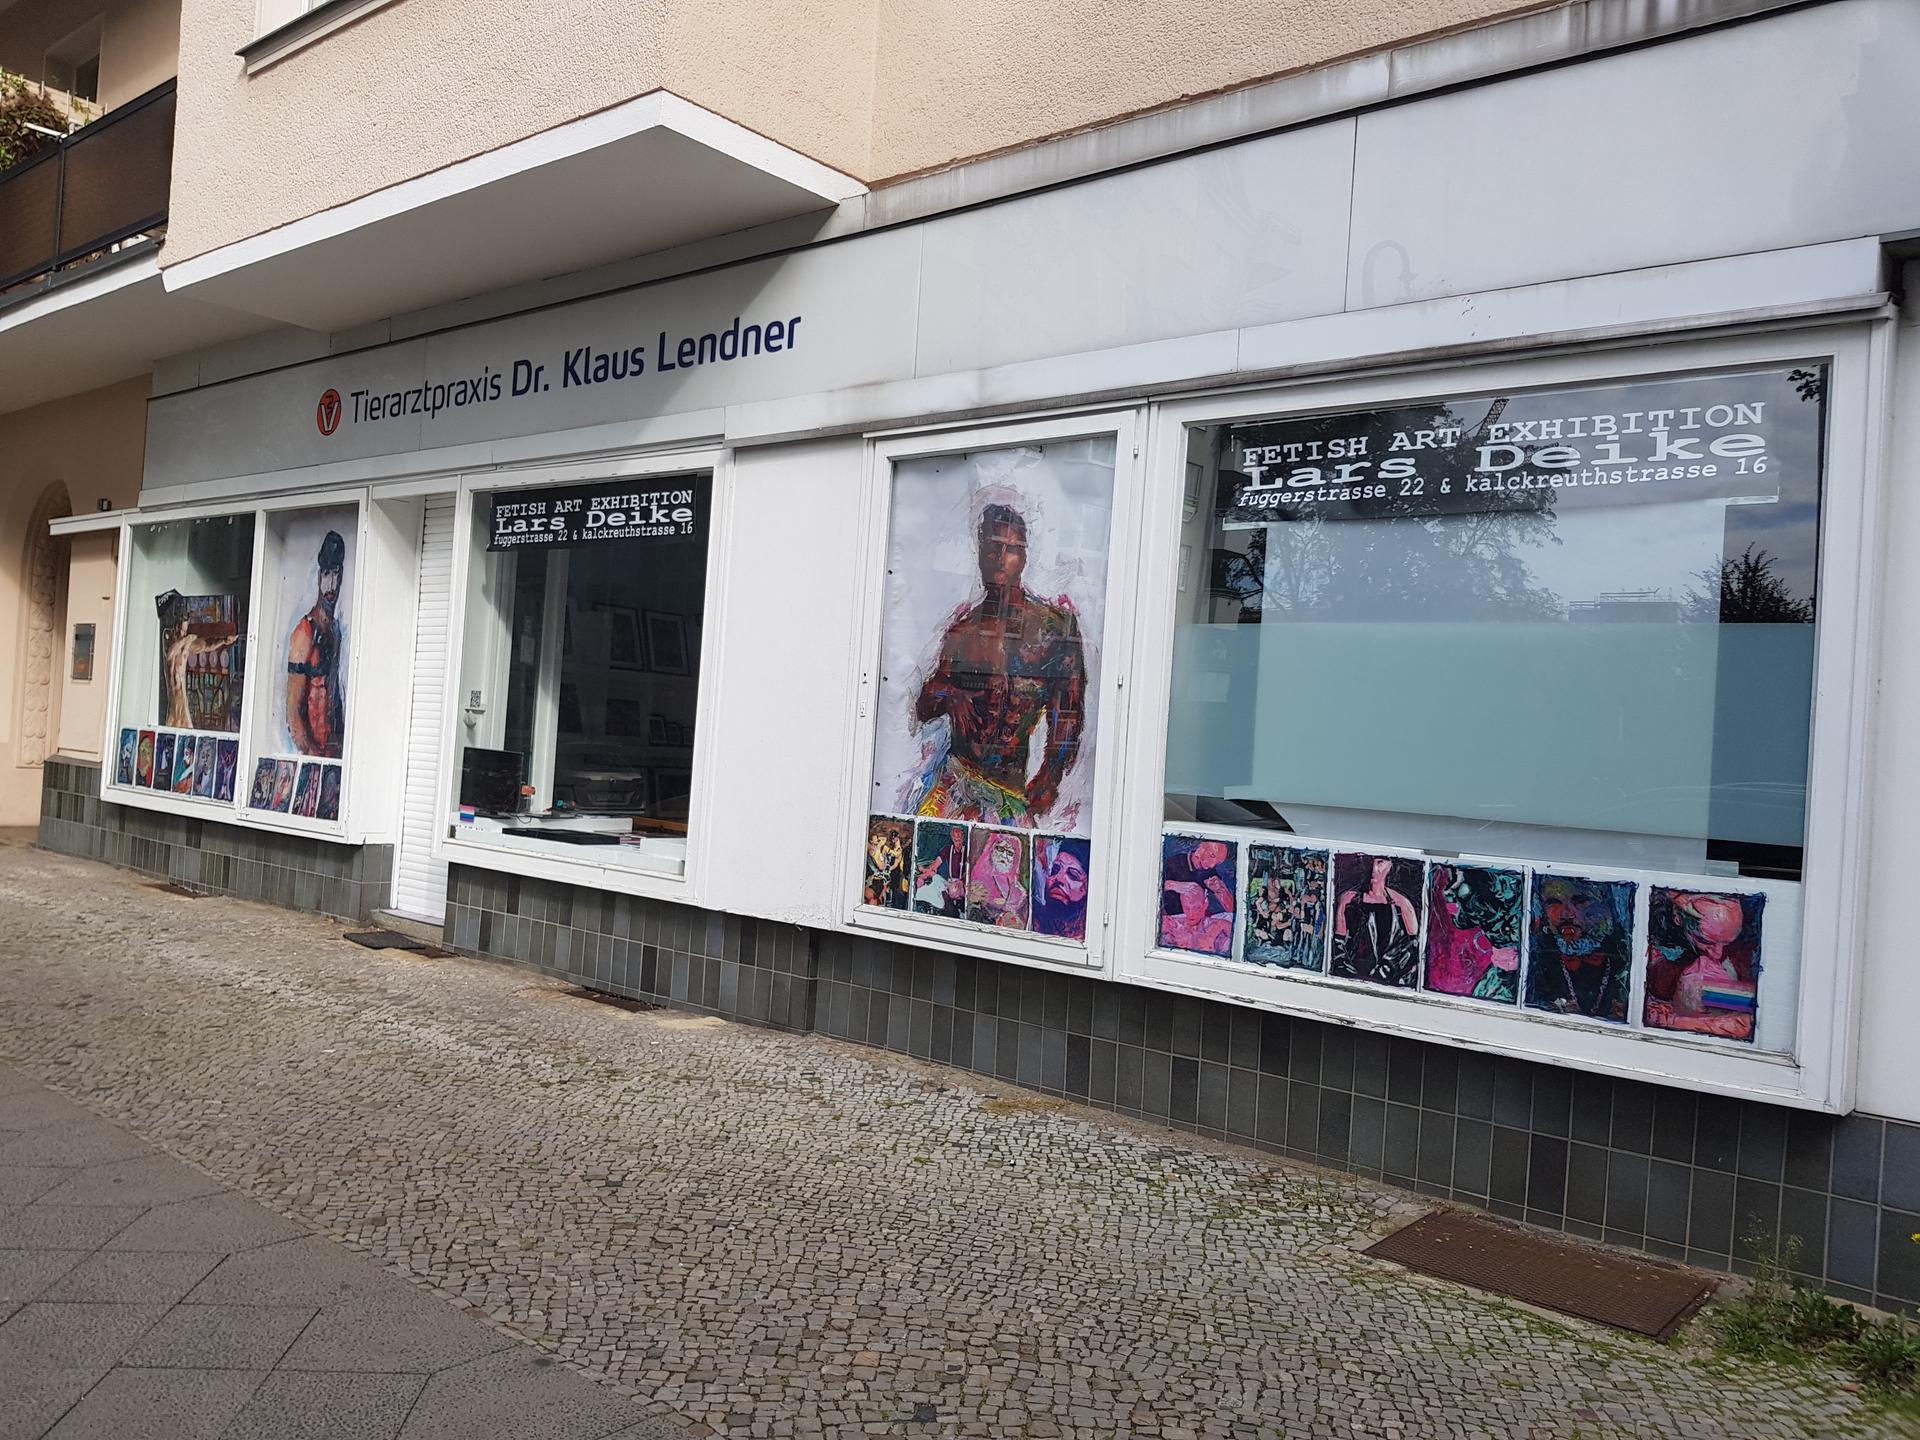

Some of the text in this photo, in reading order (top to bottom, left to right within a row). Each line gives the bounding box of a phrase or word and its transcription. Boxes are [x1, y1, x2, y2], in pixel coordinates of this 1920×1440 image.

[351, 317, 801, 423] Tierarztpraxis Dr. Klaus Lendner
[1243, 402, 1765, 466] FETISH ART EXHIBITION
[1237, 455, 1767, 508] fuggerstrasse 22 & kalckreuthstrasse 16
[1243, 431, 1766, 492] Lars Deike
[496, 490, 693, 518] FETISH ART EXHIBITION
[496, 506, 693, 533] Lars Deike
[494, 522, 693, 548] fuggerstrasse 22 & kalckreuthstrasse 16
